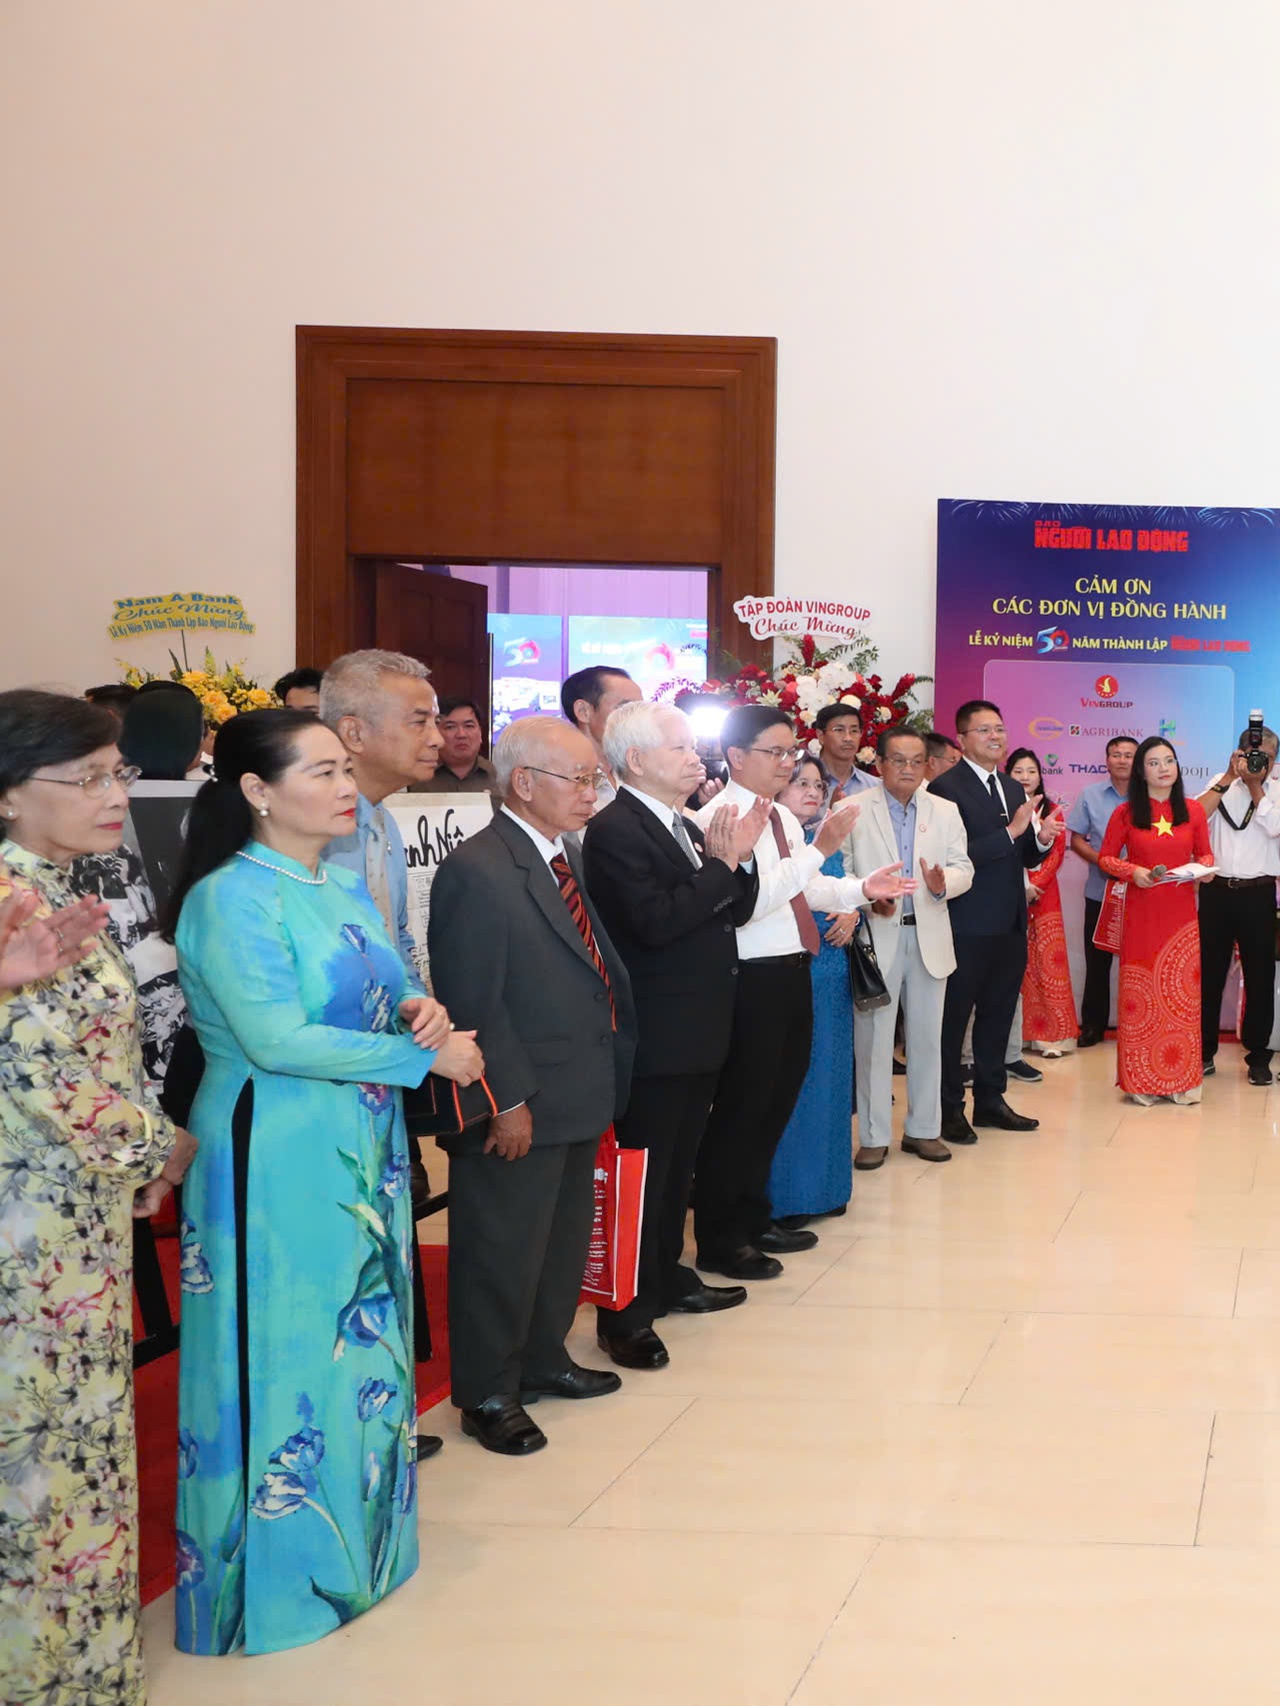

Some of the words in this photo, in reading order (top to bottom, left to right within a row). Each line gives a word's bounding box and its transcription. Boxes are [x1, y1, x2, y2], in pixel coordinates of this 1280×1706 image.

[1034, 526, 1092, 549] NGƯỜI
[1096, 528, 1133, 550] LAO
[1137, 528, 1189, 553] ĐỘNG
[1074, 574, 1118, 595] CẢM
[1124, 577, 1151, 595] ƠN
[117, 596, 164, 609] Nam
[191, 592, 240, 605] Bank
[738, 600, 764, 620] TẬP
[766, 596, 803, 614] ĐOÀN
[805, 600, 871, 621] VINGROUP
[992, 595, 1033, 615] CÁC
[1038, 599, 1081, 616] ĐƠN
[1087, 600, 1104, 619] VỊ
[1110, 597, 1167, 619] ĐỒNG
[1173, 600, 1227, 620] HÀNH
[754, 617, 800, 636] Chúc
[802, 616, 857, 640] Mừng
[968, 629, 982, 646] LỄ
[983, 632, 1000, 646] KỶ
[1002, 633, 1034, 649] NIỆM
[1036, 625, 1070, 655] 50
[1072, 635, 1101, 649] NĂM
[1102, 636, 1144, 650] THÀNH
[1146, 637, 1168, 653] LẬP
[1081, 727, 1144, 738] AGRIBANK
[1041, 764, 1064, 776] bank
[1068, 763, 1109, 774] THAC
